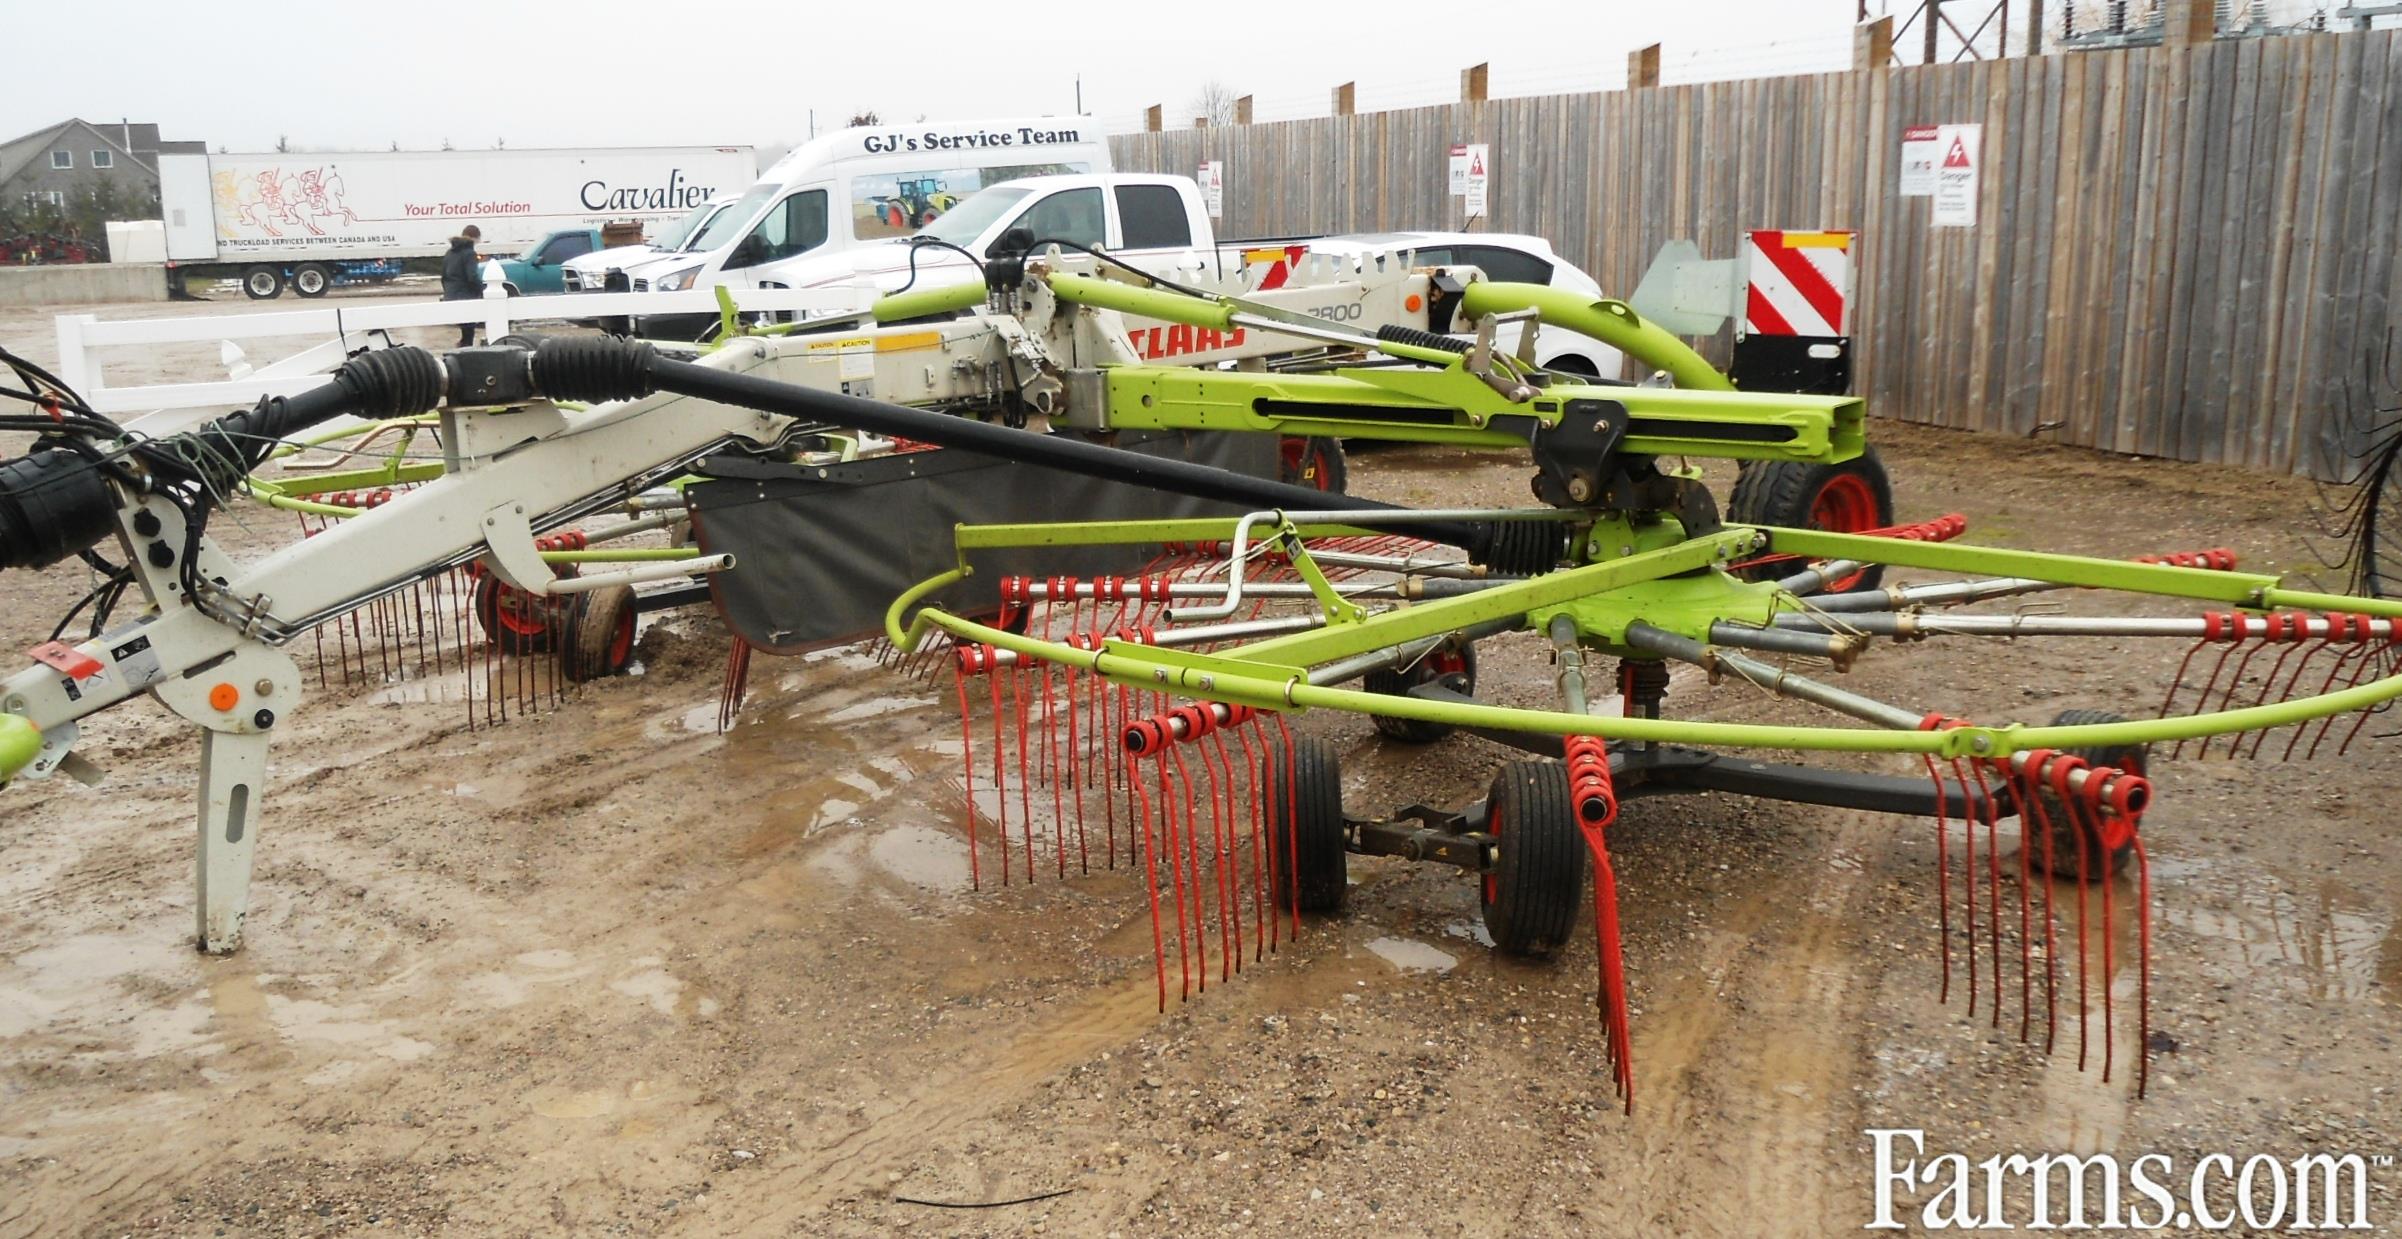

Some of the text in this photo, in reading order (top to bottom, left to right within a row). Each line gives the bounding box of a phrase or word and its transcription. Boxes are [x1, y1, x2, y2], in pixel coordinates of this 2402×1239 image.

[863, 127, 1080, 153] GJ's Service Team
[580, 168, 716, 211] Cavalier
[404, 200, 531, 216] Your Total Solution
[230, 238, 270, 247] TRUCKLOAD
[272, 237, 304, 246] SERVICES
[306, 237, 336, 245] BETWEEN
[339, 236, 365, 244] CANADA
[367, 235, 380, 243] AND
